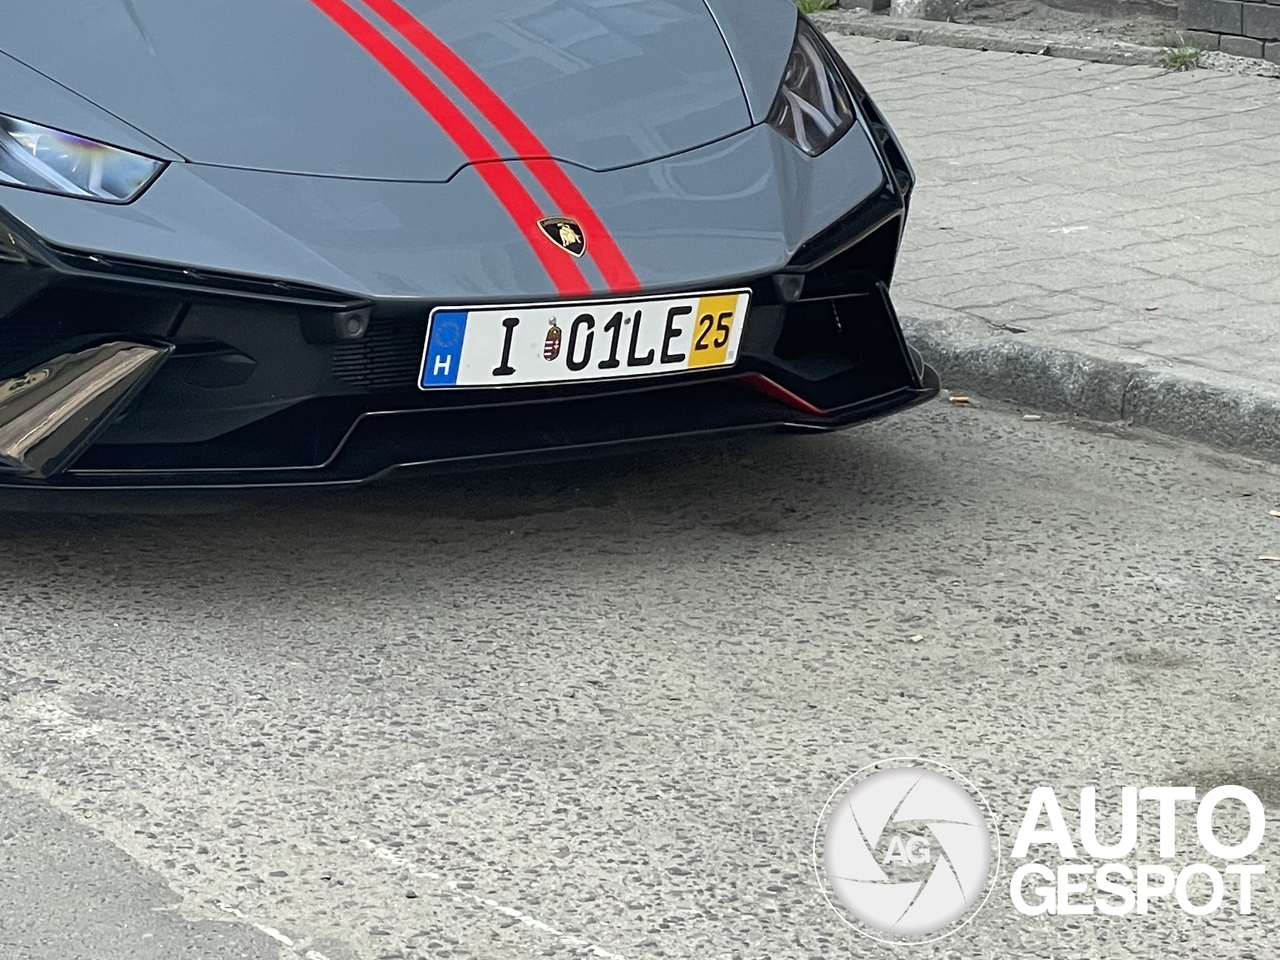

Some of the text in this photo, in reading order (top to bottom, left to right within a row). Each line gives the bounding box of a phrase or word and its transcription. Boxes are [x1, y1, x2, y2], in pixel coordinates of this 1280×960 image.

[492, 306, 734, 377] I 01LE 25
[433, 354, 451, 377] H
